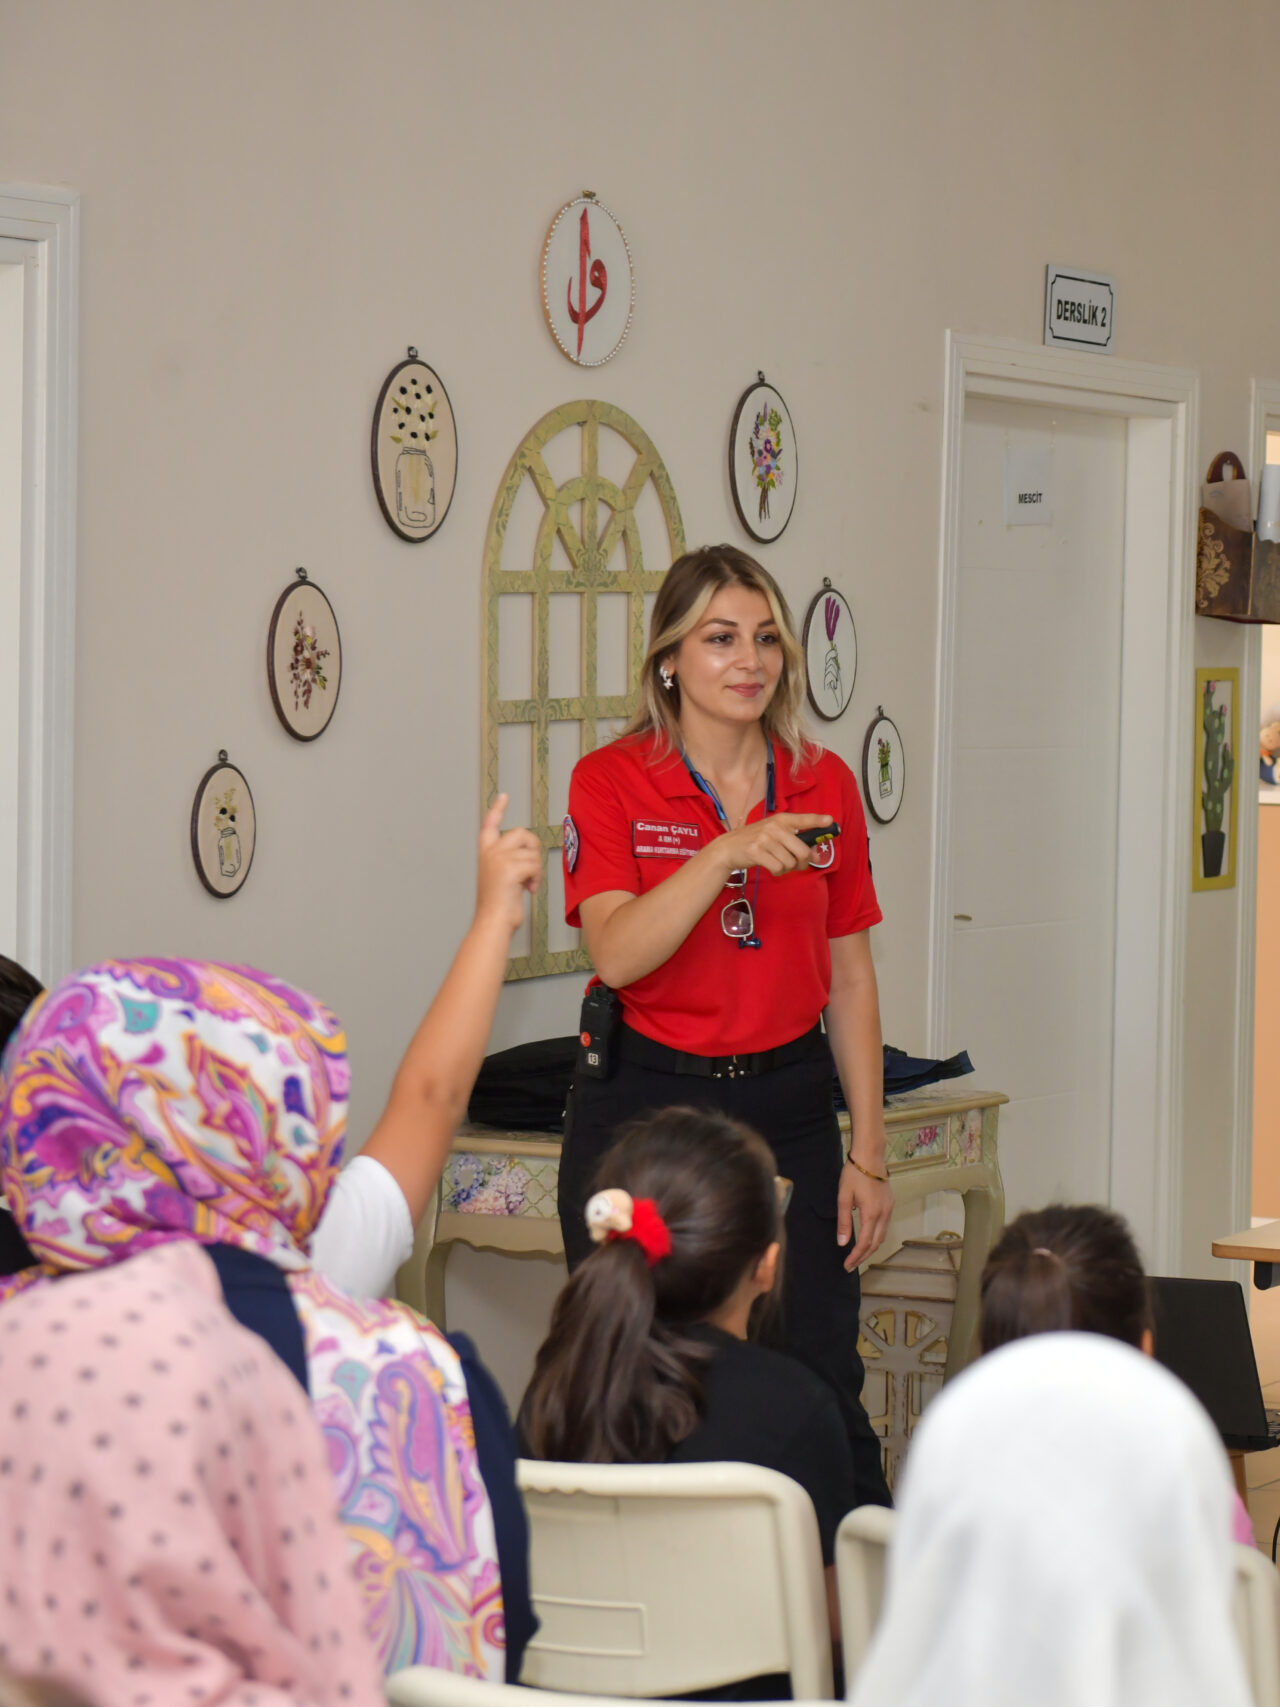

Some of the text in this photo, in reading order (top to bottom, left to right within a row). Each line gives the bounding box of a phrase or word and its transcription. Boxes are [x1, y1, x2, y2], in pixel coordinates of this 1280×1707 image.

[1056, 299, 1107, 327] DERSLİK 2
[1018, 491, 1043, 504] MESCİT
[636, 822, 698, 836] Canan ÇAYLI
